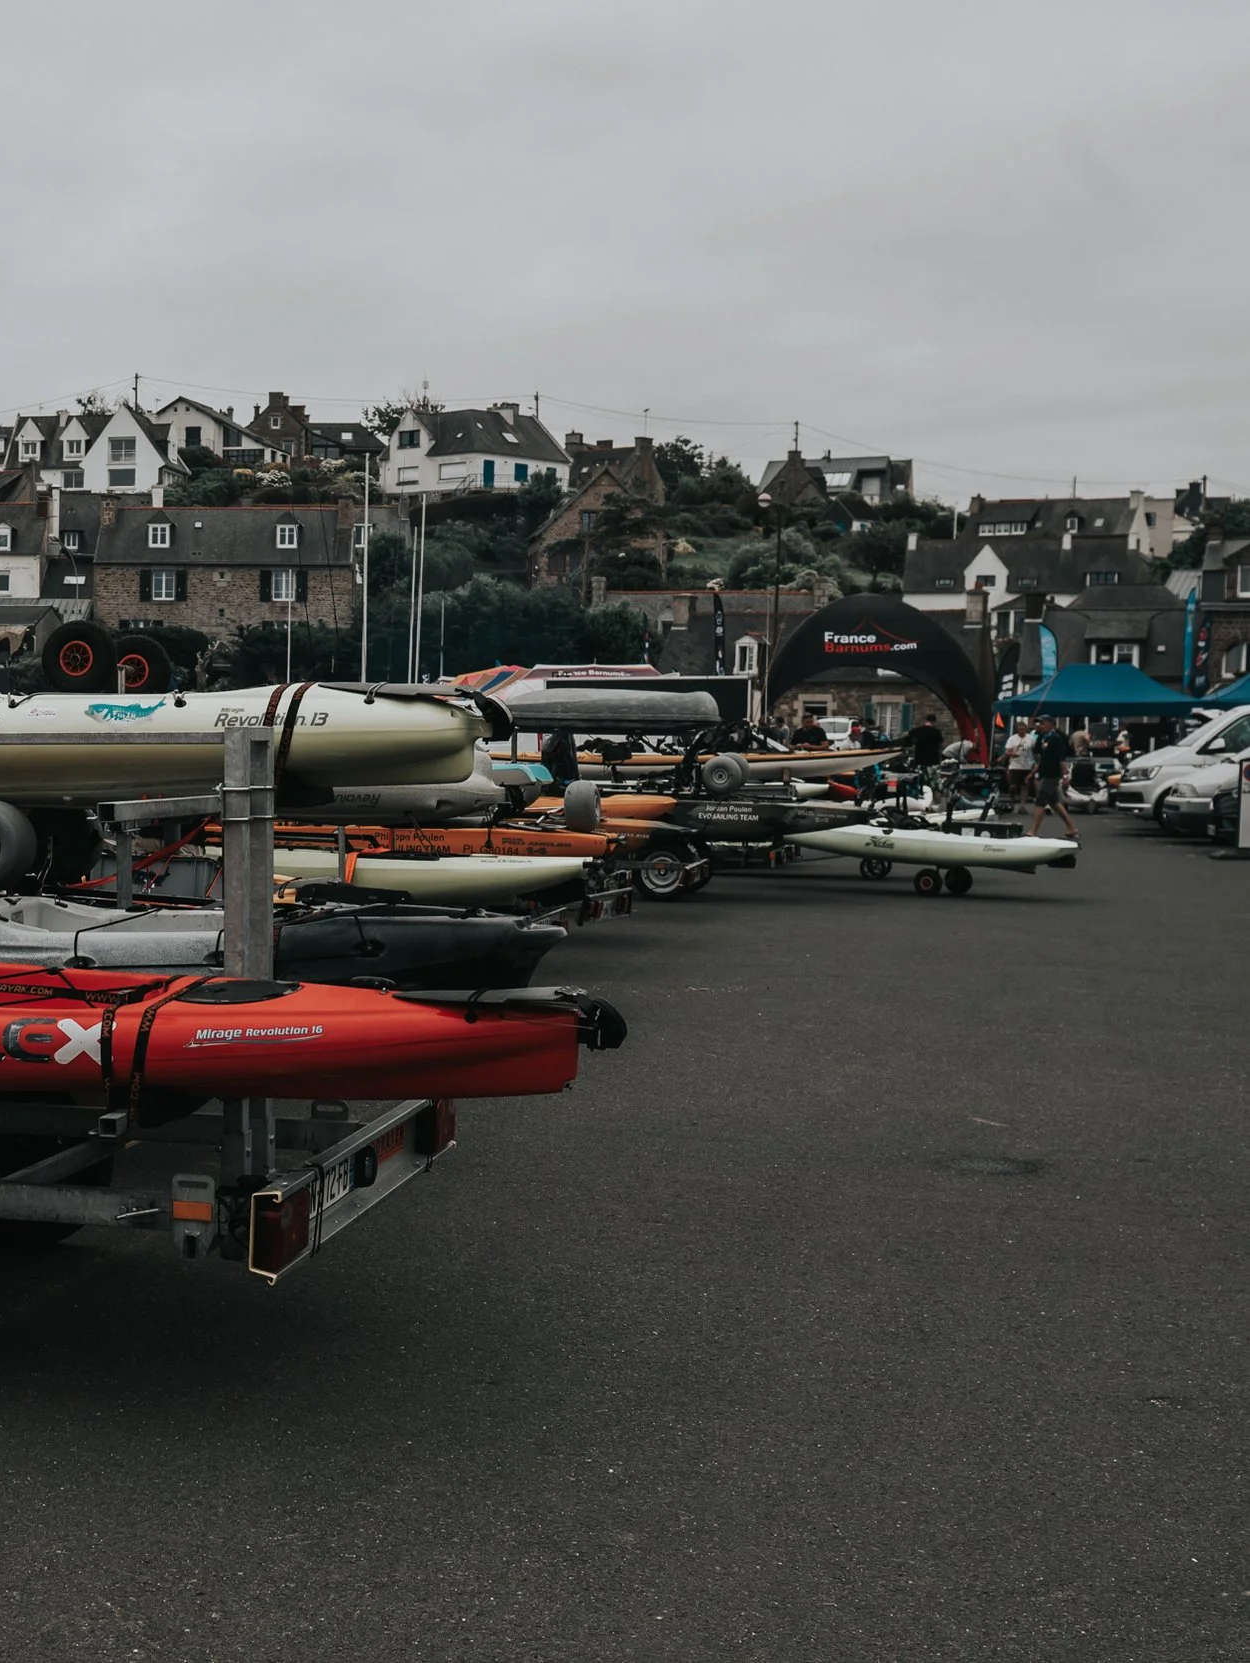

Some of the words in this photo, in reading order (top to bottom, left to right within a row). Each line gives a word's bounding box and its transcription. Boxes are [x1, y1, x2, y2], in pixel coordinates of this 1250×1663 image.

[824, 631, 877, 644] France
[214, 712, 306, 727] Revoltin
[310, 712, 330, 727] 13
[706, 804, 728, 812] Joran
[196, 1028, 243, 1040] Mirage
[245, 1025, 309, 1037] Revolution
[312, 1025, 323, 1034] 16
